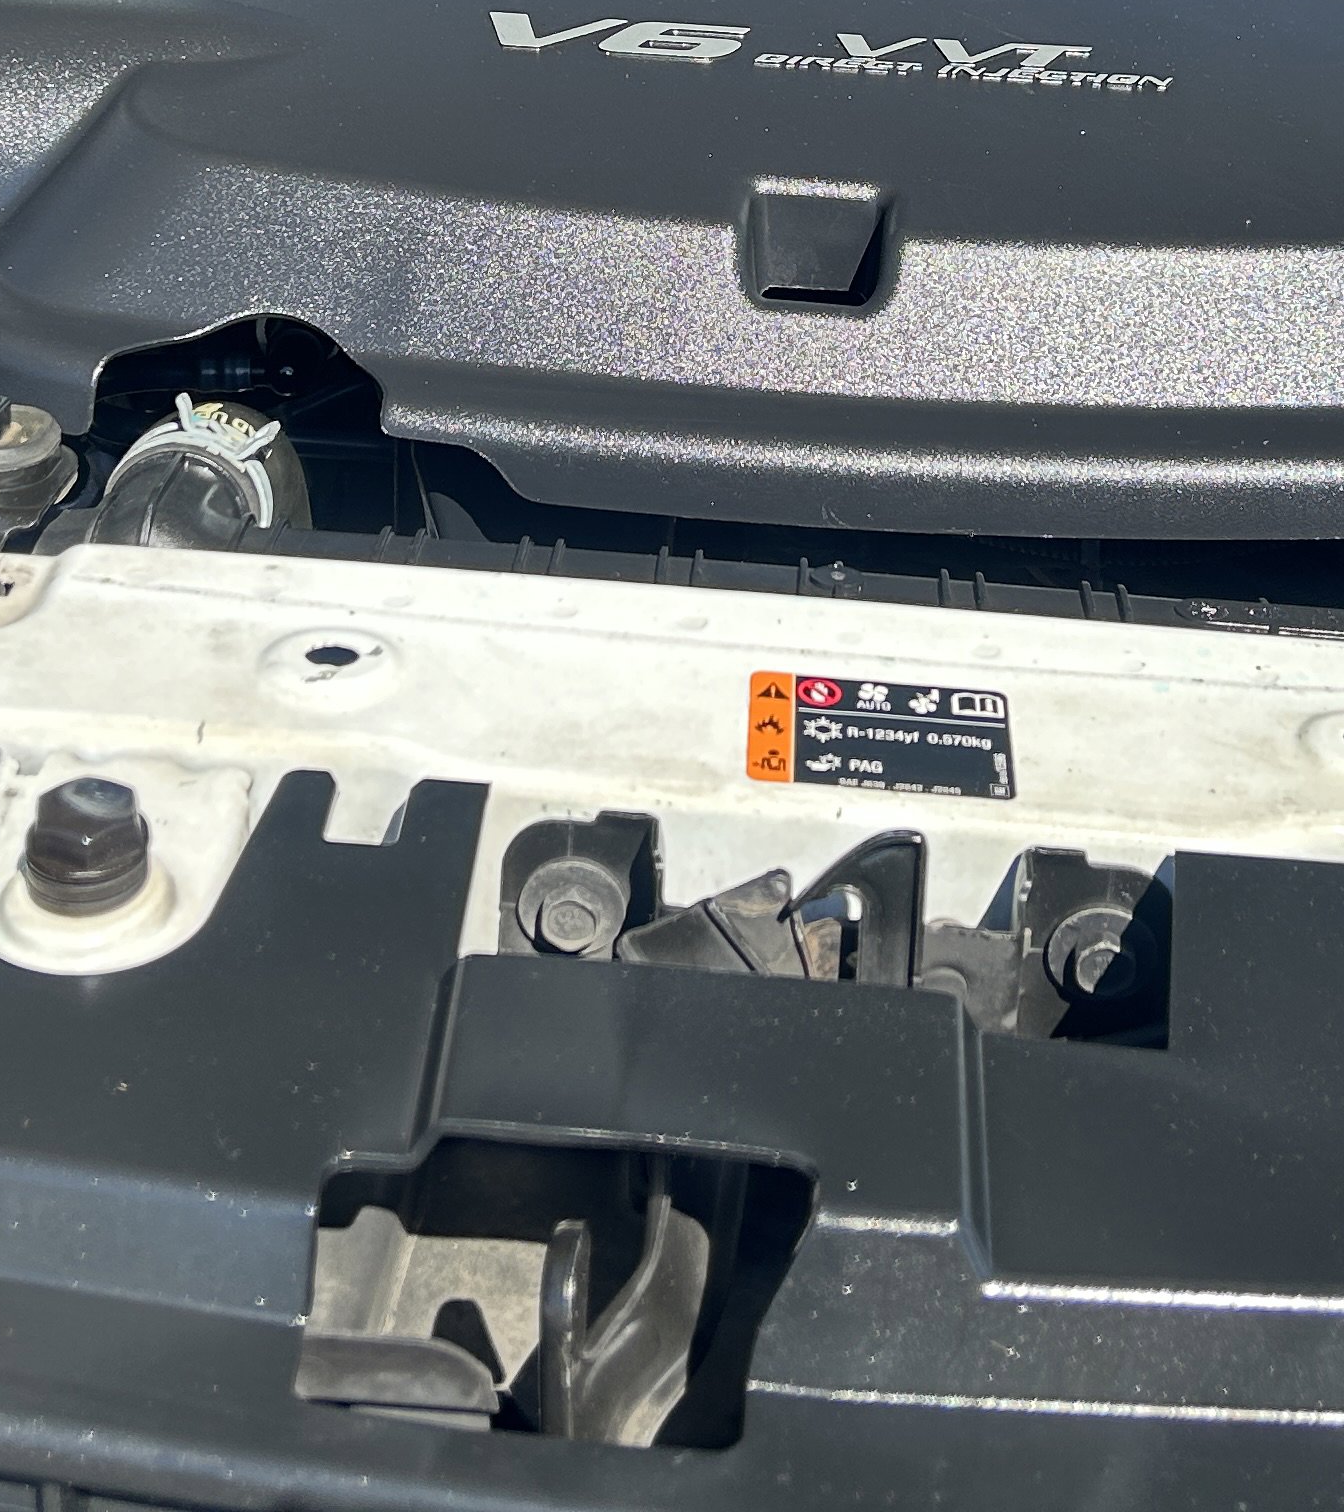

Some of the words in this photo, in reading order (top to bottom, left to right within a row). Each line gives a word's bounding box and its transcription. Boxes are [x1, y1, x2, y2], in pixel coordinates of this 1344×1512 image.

[489, 11, 752, 63] V6
[836, 33, 1094, 68] VVT
[754, 53, 923, 76] DIRECT
[937, 64, 1174, 92] INJECTION
[856, 699, 892, 712] AUTO
[846, 726, 920, 745] R-1234yf
[849, 758, 884, 774] PAG
